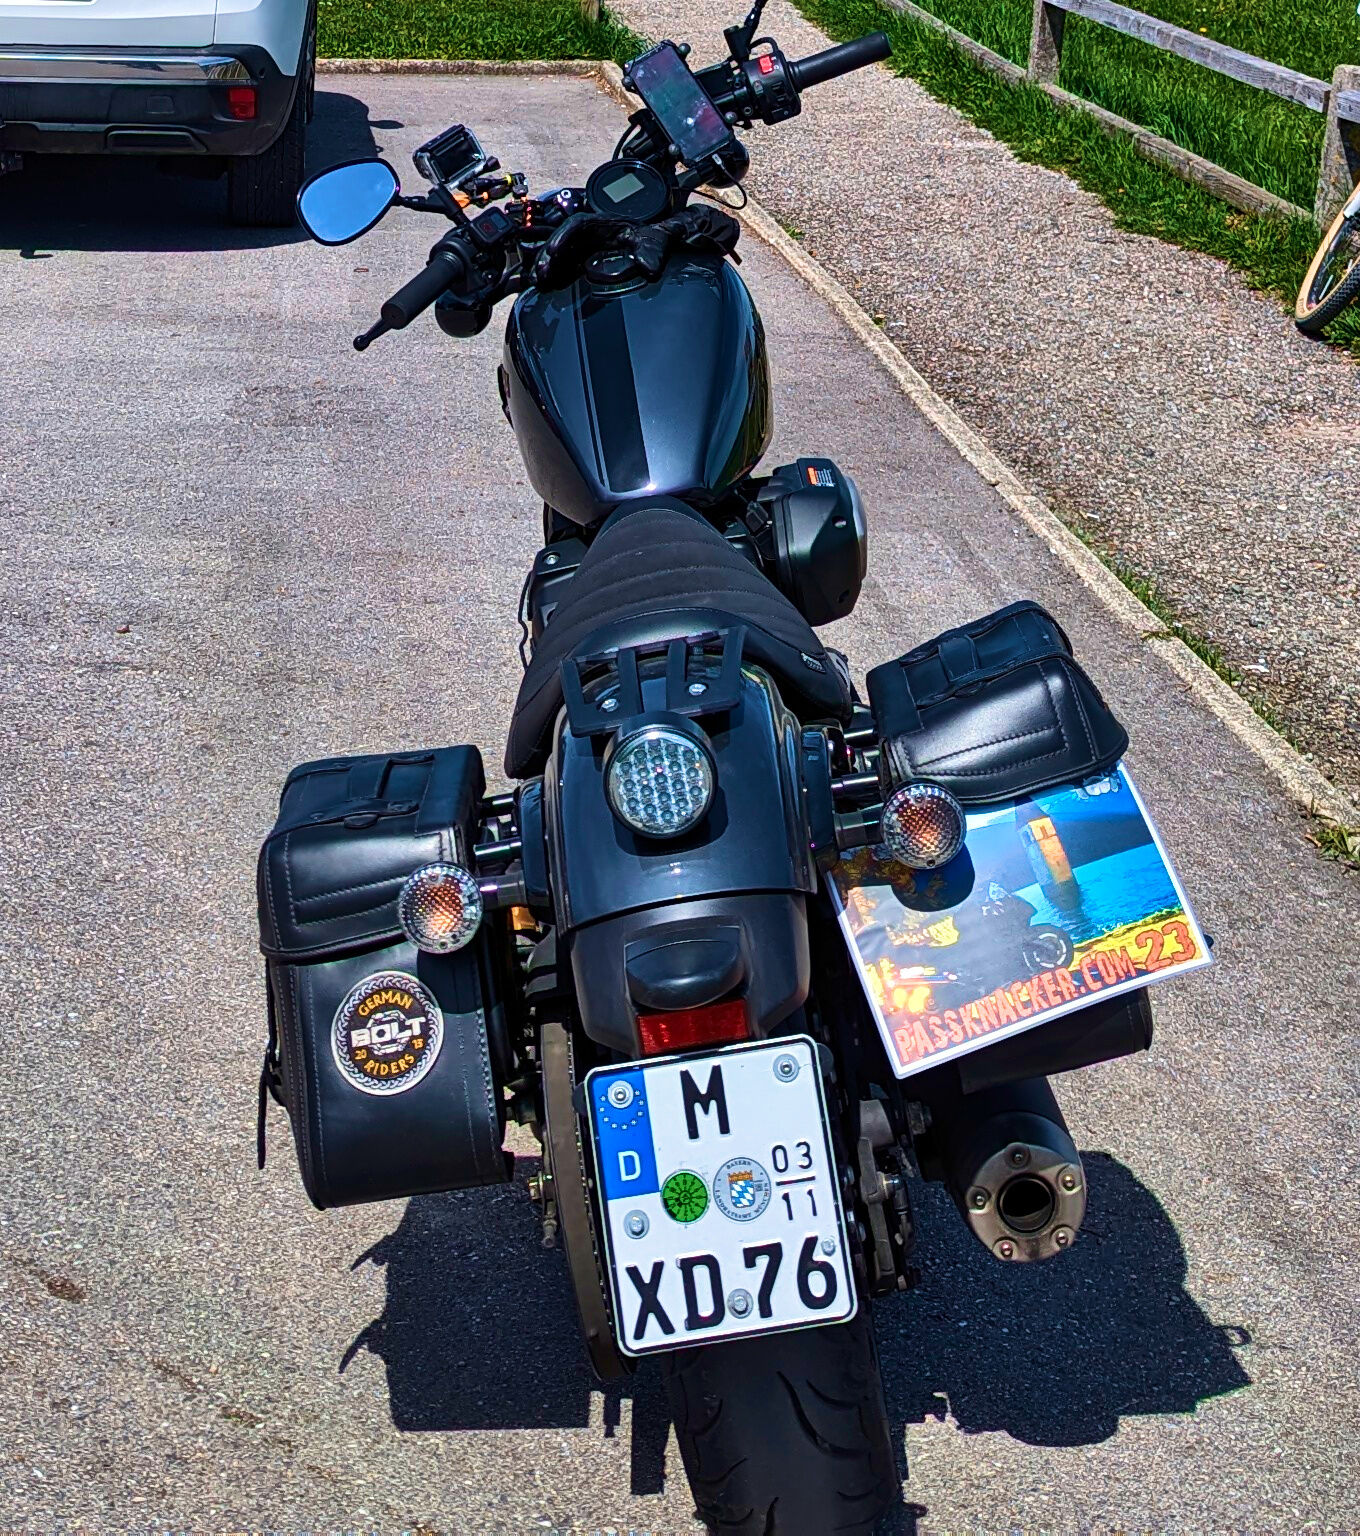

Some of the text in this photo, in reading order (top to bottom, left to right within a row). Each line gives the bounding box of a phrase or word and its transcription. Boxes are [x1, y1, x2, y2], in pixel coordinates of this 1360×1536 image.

[358, 990, 414, 1016] GERMAN
[894, 919, 1196, 1063] PASSKNACKER.COM 23
[350, 1016, 426, 1047] BOLT
[354, 1049, 368, 1060] 20
[363, 1053, 415, 1076] RIDERS
[679, 1064, 730, 1140] M
[617, 1150, 641, 1182] D
[771, 1141, 813, 1174] 03
[782, 1189, 817, 1221] 11
[625, 1235, 838, 1341] XD 76
